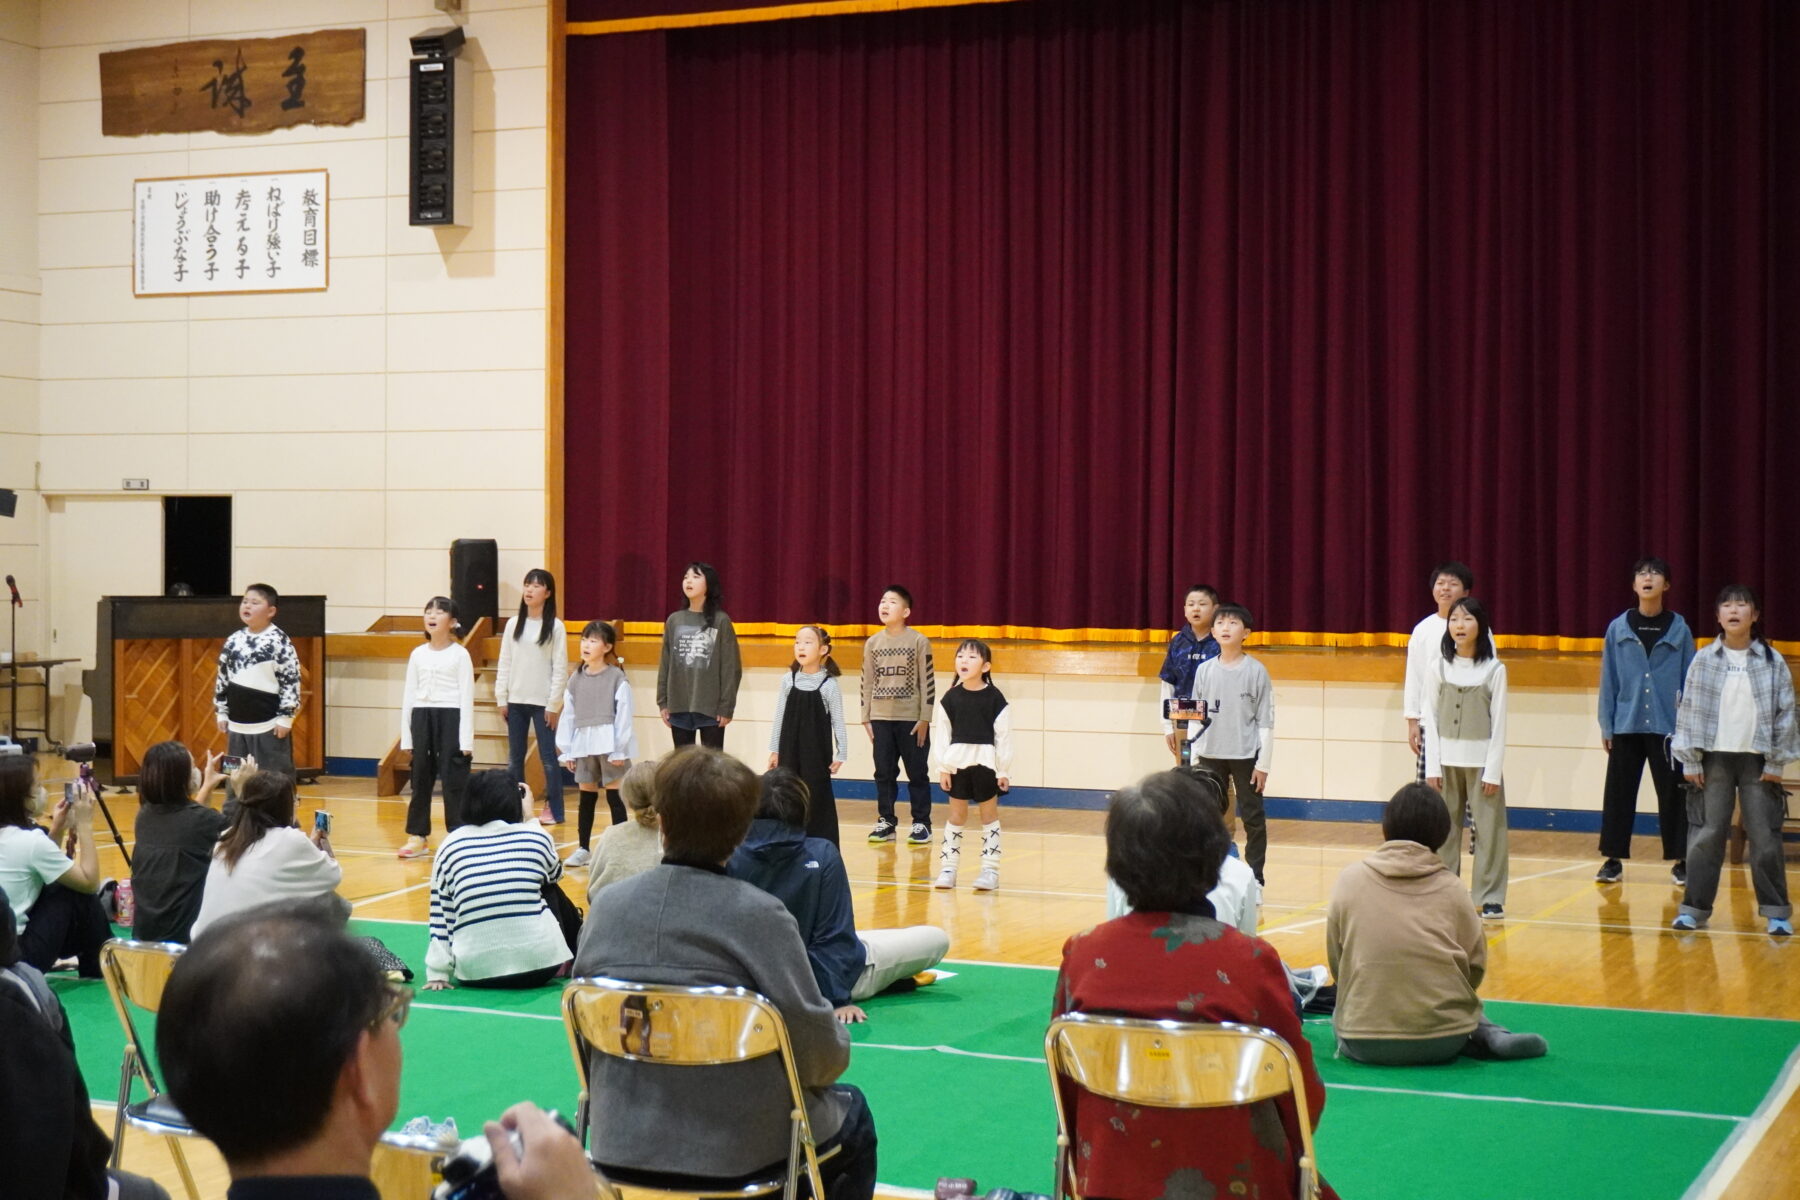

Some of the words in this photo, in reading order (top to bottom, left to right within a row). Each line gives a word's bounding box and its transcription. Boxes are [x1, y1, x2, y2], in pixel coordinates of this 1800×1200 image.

[173, 191, 191, 283] じょうぶな子
[203, 189, 222, 281] 助け合う子
[234, 188, 252, 280] 考える子
[265, 185, 286, 279] ねばり強い子
[301, 187, 321, 268] 教育目標
